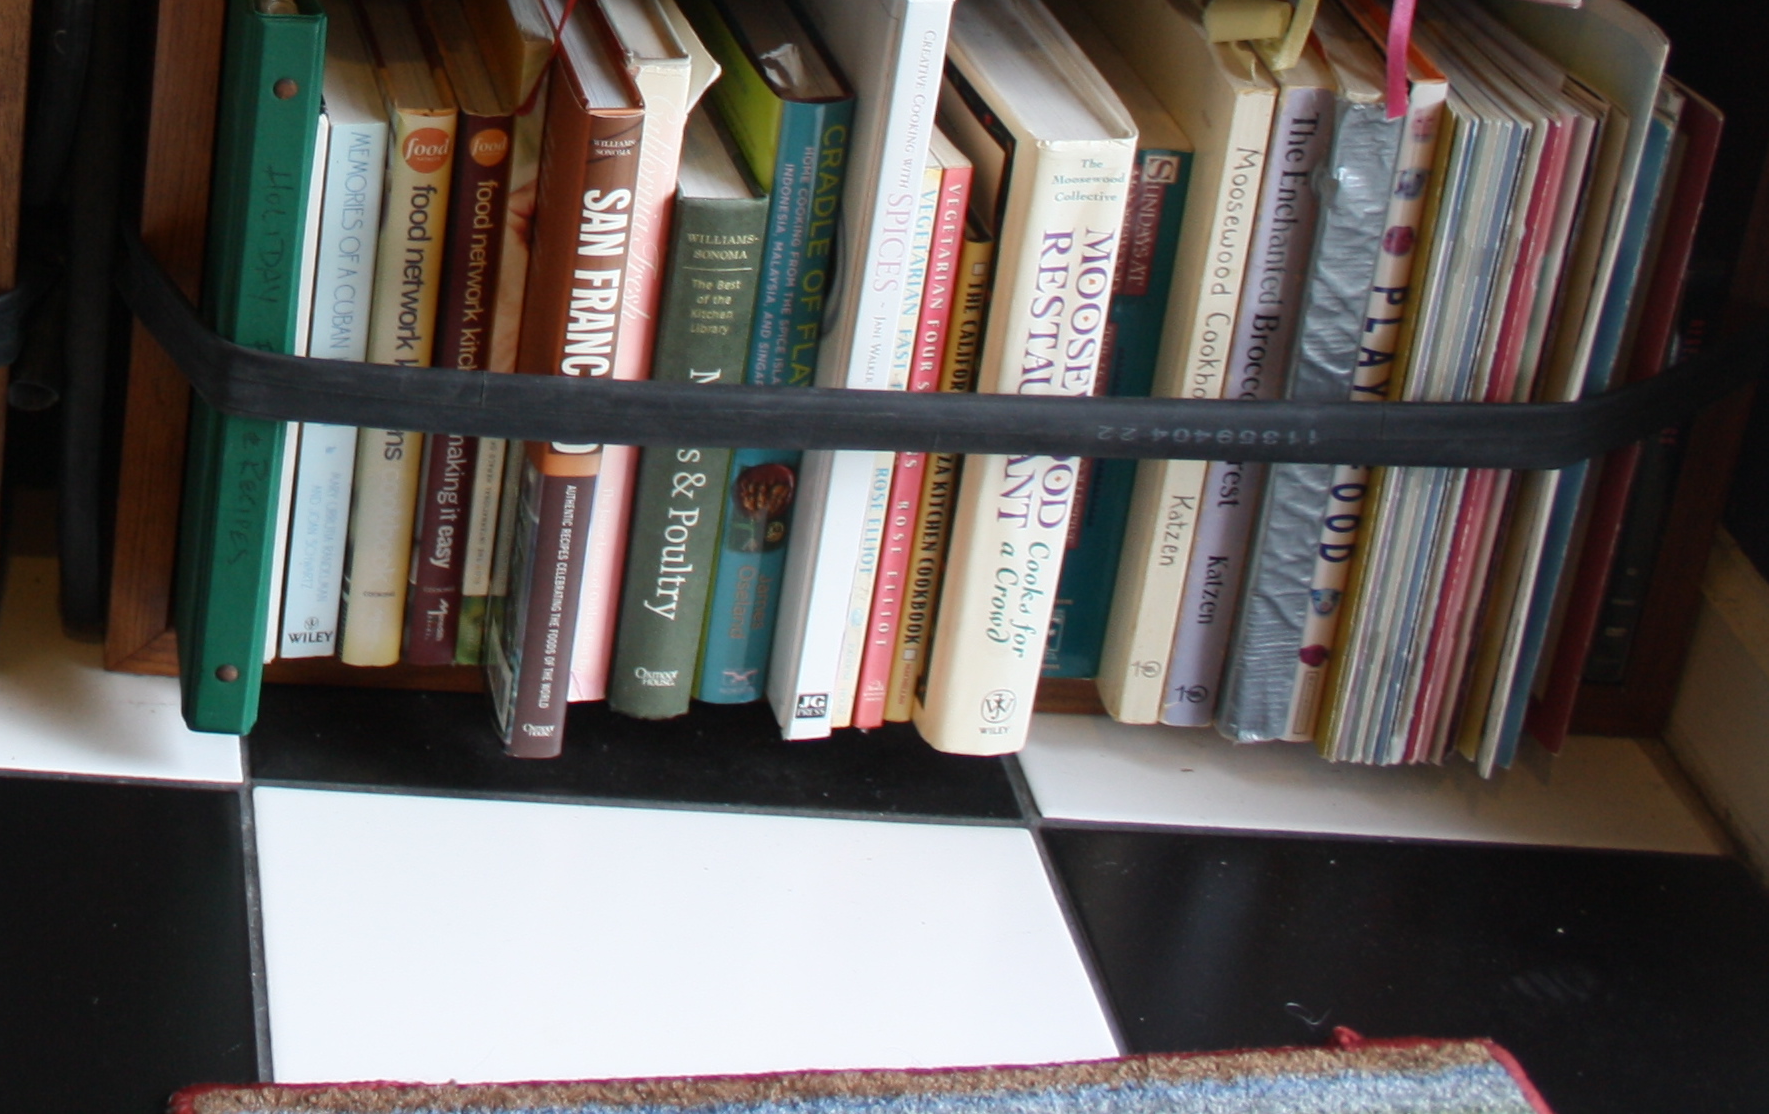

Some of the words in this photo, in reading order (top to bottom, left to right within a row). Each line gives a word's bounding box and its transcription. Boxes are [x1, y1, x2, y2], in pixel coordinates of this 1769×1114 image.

[404, 134, 449, 157] food
[905, 94, 926, 154] COOKING
[1286, 113, 1320, 171] The
[341, 132, 371, 230] MEMORIES
[806, 125, 846, 258] CRADLE
[1052, 174, 1125, 185] Moosewood
[1081, 159, 1103, 169] The
[408, 184, 438, 245] food
[473, 180, 498, 233] food
[579, 188, 631, 256] SAN
[794, 187, 809, 250] COOKING
[1054, 191, 1117, 203] Collective
[1212, 146, 1264, 297] Moosewood
[339, 237, 361, 260] OF
[688, 234, 760, 245] WILLIAMS-
[693, 249, 747, 260] SONOMA
[873, 193, 913, 292] SPICES
[902, 190, 937, 316] VEGETARIAN
[930, 184, 962, 309] VEGETARIAN
[1258, 171, 1308, 313] Enchanted
[395, 248, 425, 350] network
[463, 238, 488, 322] network
[691, 279, 713, 290] The
[717, 278, 741, 290] Best
[801, 269, 825, 311] OF
[330, 285, 355, 349] CUBAN
[690, 323, 729, 336] Library
[691, 309, 734, 320] Kitchen
[892, 329, 913, 371] FAST
[919, 320, 939, 372] FOUR
[562, 485, 577, 526] AUTHENTIC
[672, 472, 706, 499] &
[872, 468, 889, 510] ROSE
[557, 528, 573, 560] RECIPES
[891, 501, 909, 553] ROSE
[922, 482, 947, 552] KITCHEN
[1159, 495, 1195, 567] Katzen
[430, 525, 454, 569] easy
[644, 507, 700, 620] Poultry
[859, 518, 881, 574] ELLIOT
[551, 562, 569, 612] CELEBRATING
[730, 566, 756, 639] Oseland
[904, 558, 934, 645] COOKBOOK
[987, 568, 1019, 644] Crowd
[1019, 542, 1050, 614] Cooks
[1197, 555, 1228, 625] Katzen
[875, 571, 898, 646] ELLIOT
[288, 632, 333, 643] WILEY
[1010, 618, 1036, 659] for
